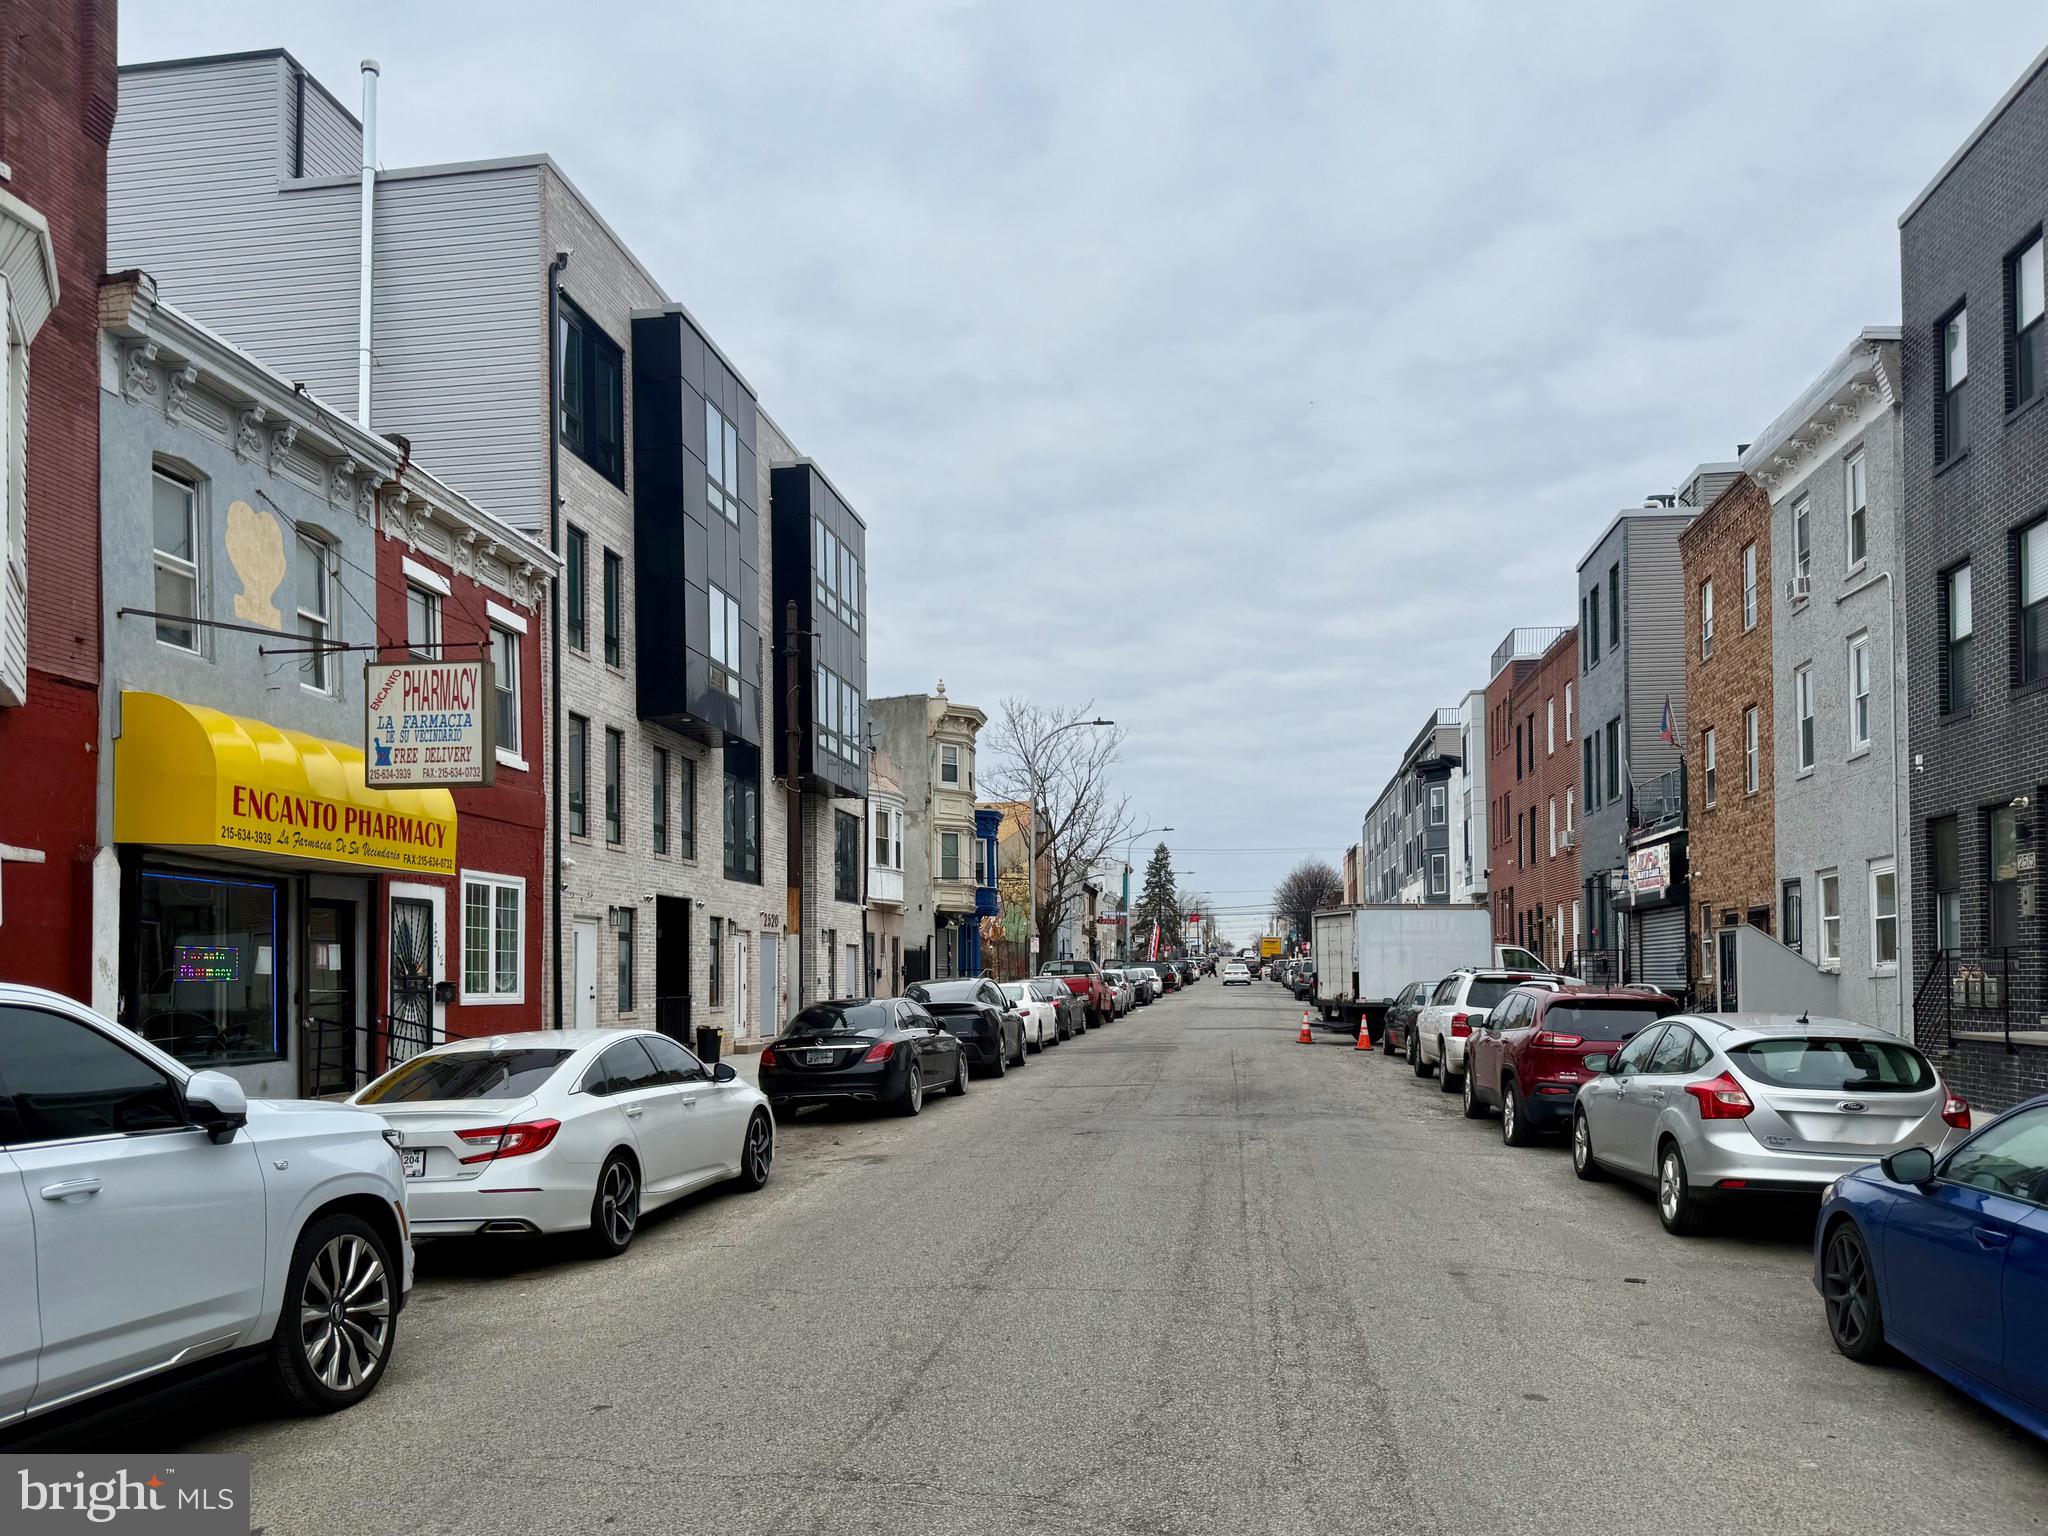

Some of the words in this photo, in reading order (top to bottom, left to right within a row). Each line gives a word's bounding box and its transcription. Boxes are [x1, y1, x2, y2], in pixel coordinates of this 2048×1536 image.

[370, 669, 402, 711] ENCANTO
[403, 668, 478, 711] PHARMACY
[377, 716, 394, 729] LA
[402, 713, 472, 728] FARMACIA
[386, 731, 395, 743] DE
[400, 730, 409, 743] SU
[415, 729, 462, 742] VECINDARIO
[393, 748, 418, 763] FREE
[425, 747, 472, 763] DELIVERY
[370, 768, 411, 780] 215-634-3939
[232, 785, 338, 832] ENCANTO
[344, 807, 447, 849] PHARMACY
[221, 825, 272, 845] 215-634-3939
[276, 829, 289, 845] La
[290, 832, 332, 851] Farmacia
[335, 838, 347, 853] De
[348, 841, 361, 855] Su
[362, 841, 401, 860] Vecindario
[764, 913, 778, 928] 2520
[403, 1156, 420, 1165] 204
